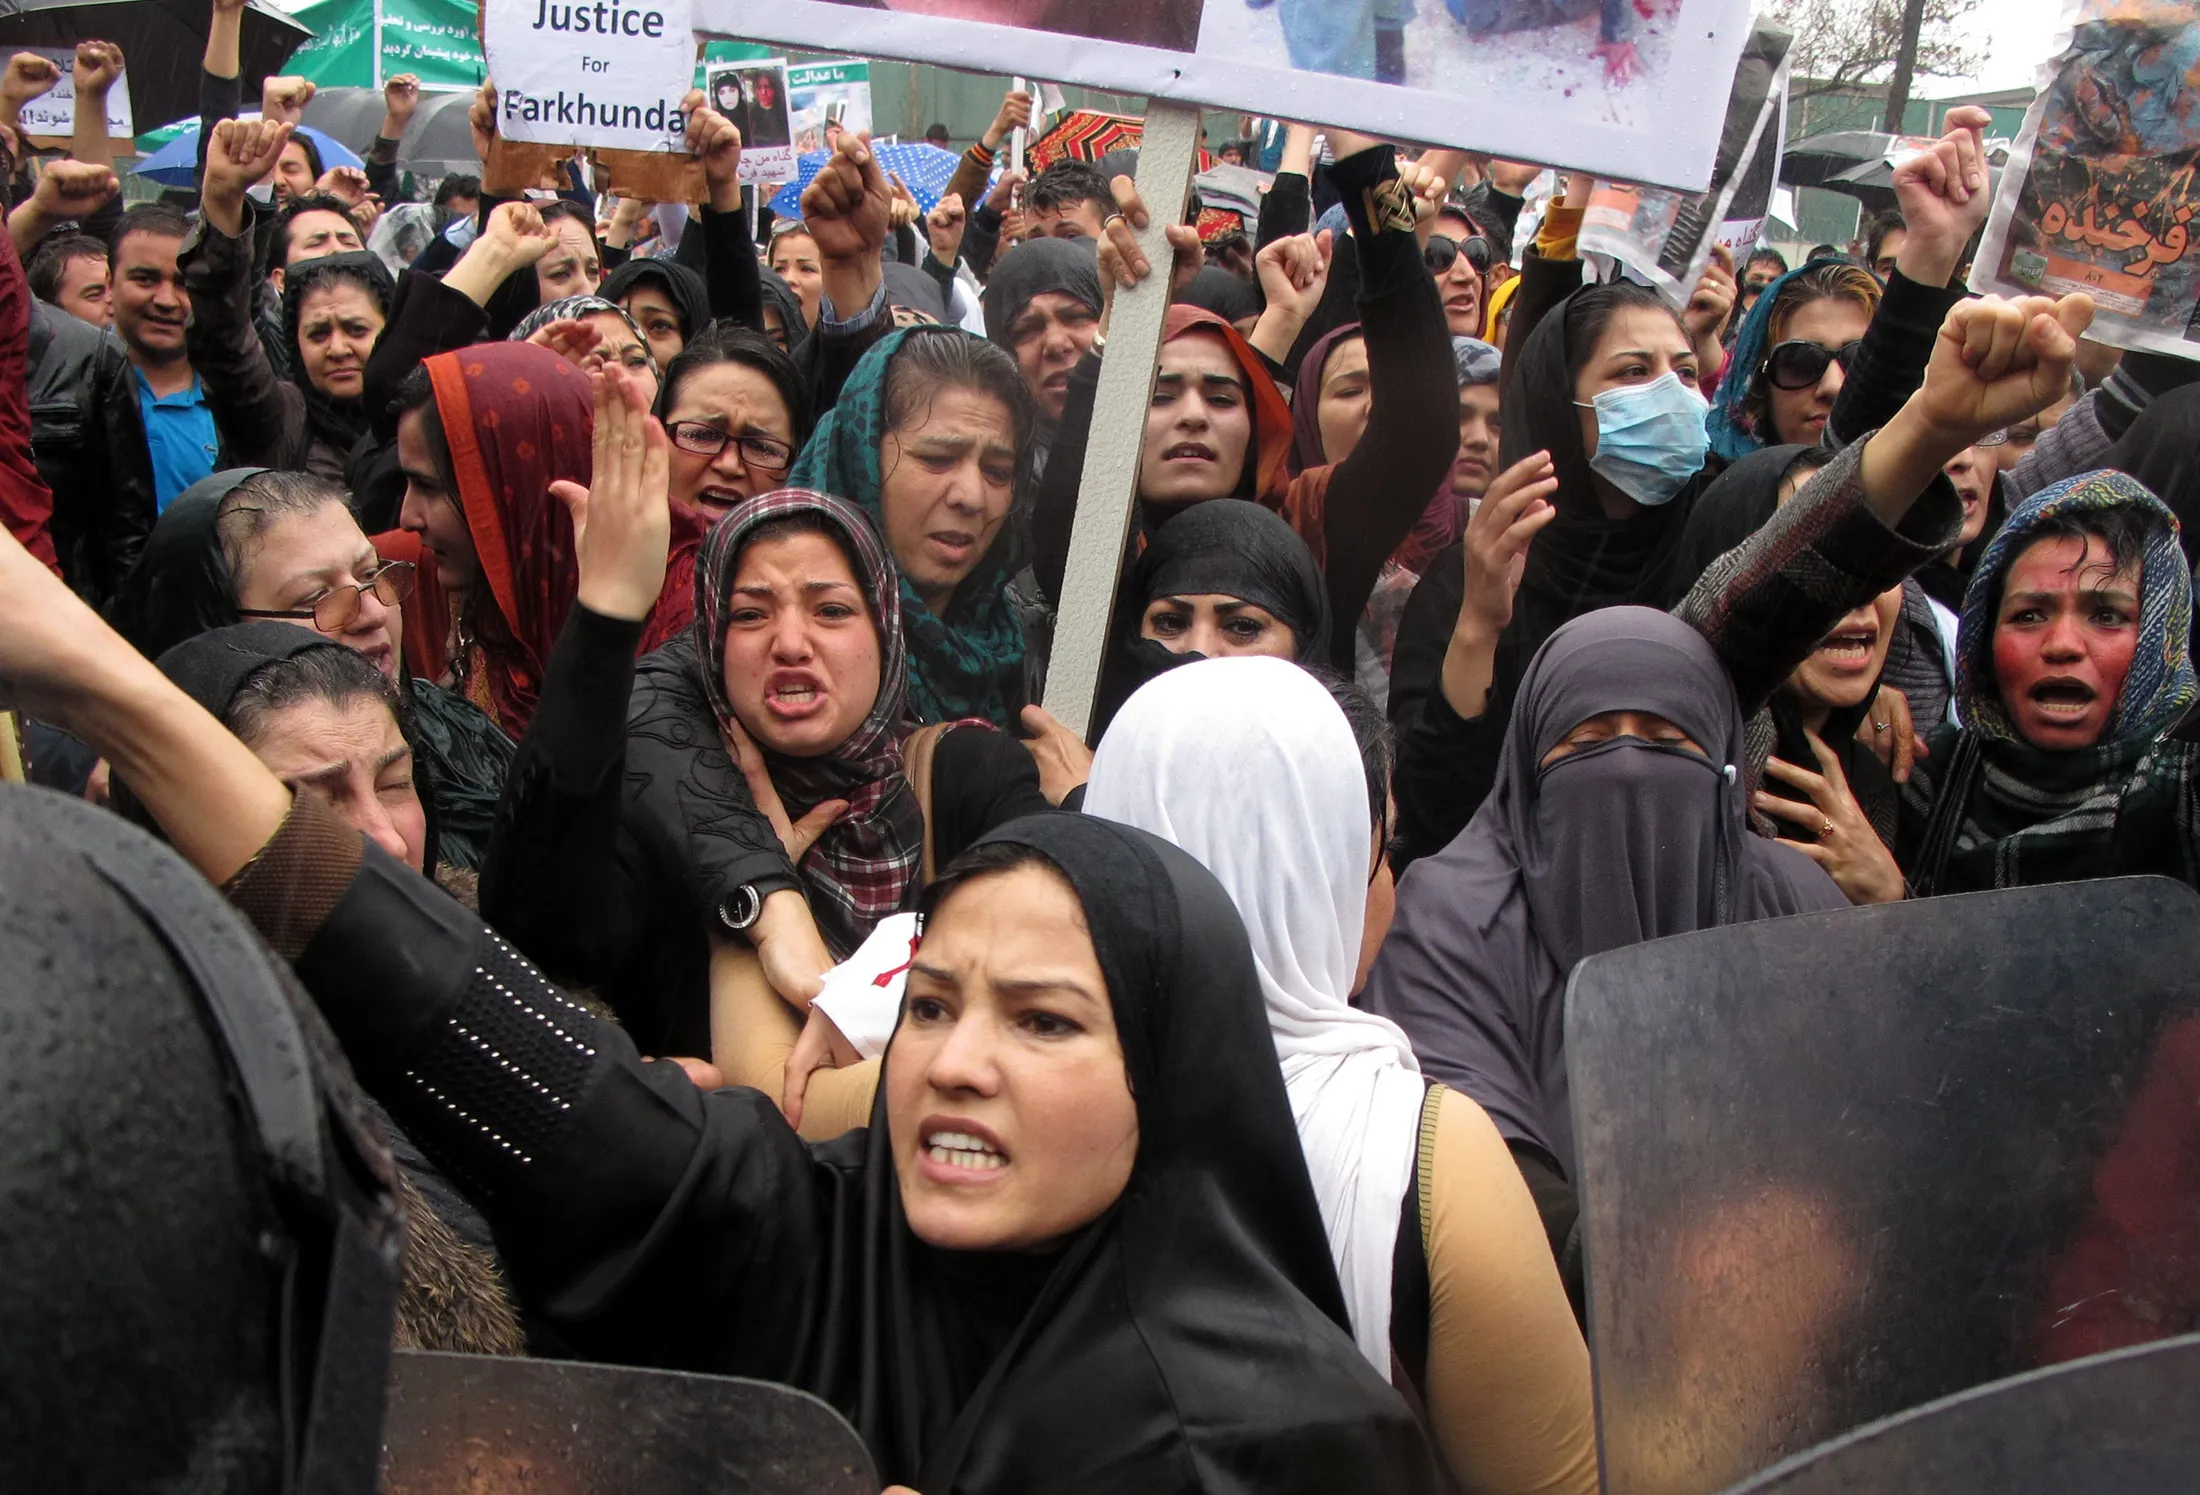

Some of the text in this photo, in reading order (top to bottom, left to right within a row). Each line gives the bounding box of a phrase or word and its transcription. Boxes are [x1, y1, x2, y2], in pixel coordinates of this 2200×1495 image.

[532, 0, 664, 38] Justice
[581, 56, 610, 73] For
[505, 90, 686, 133] Farkhunda
[2041, 201, 2189, 277] فرخنده
